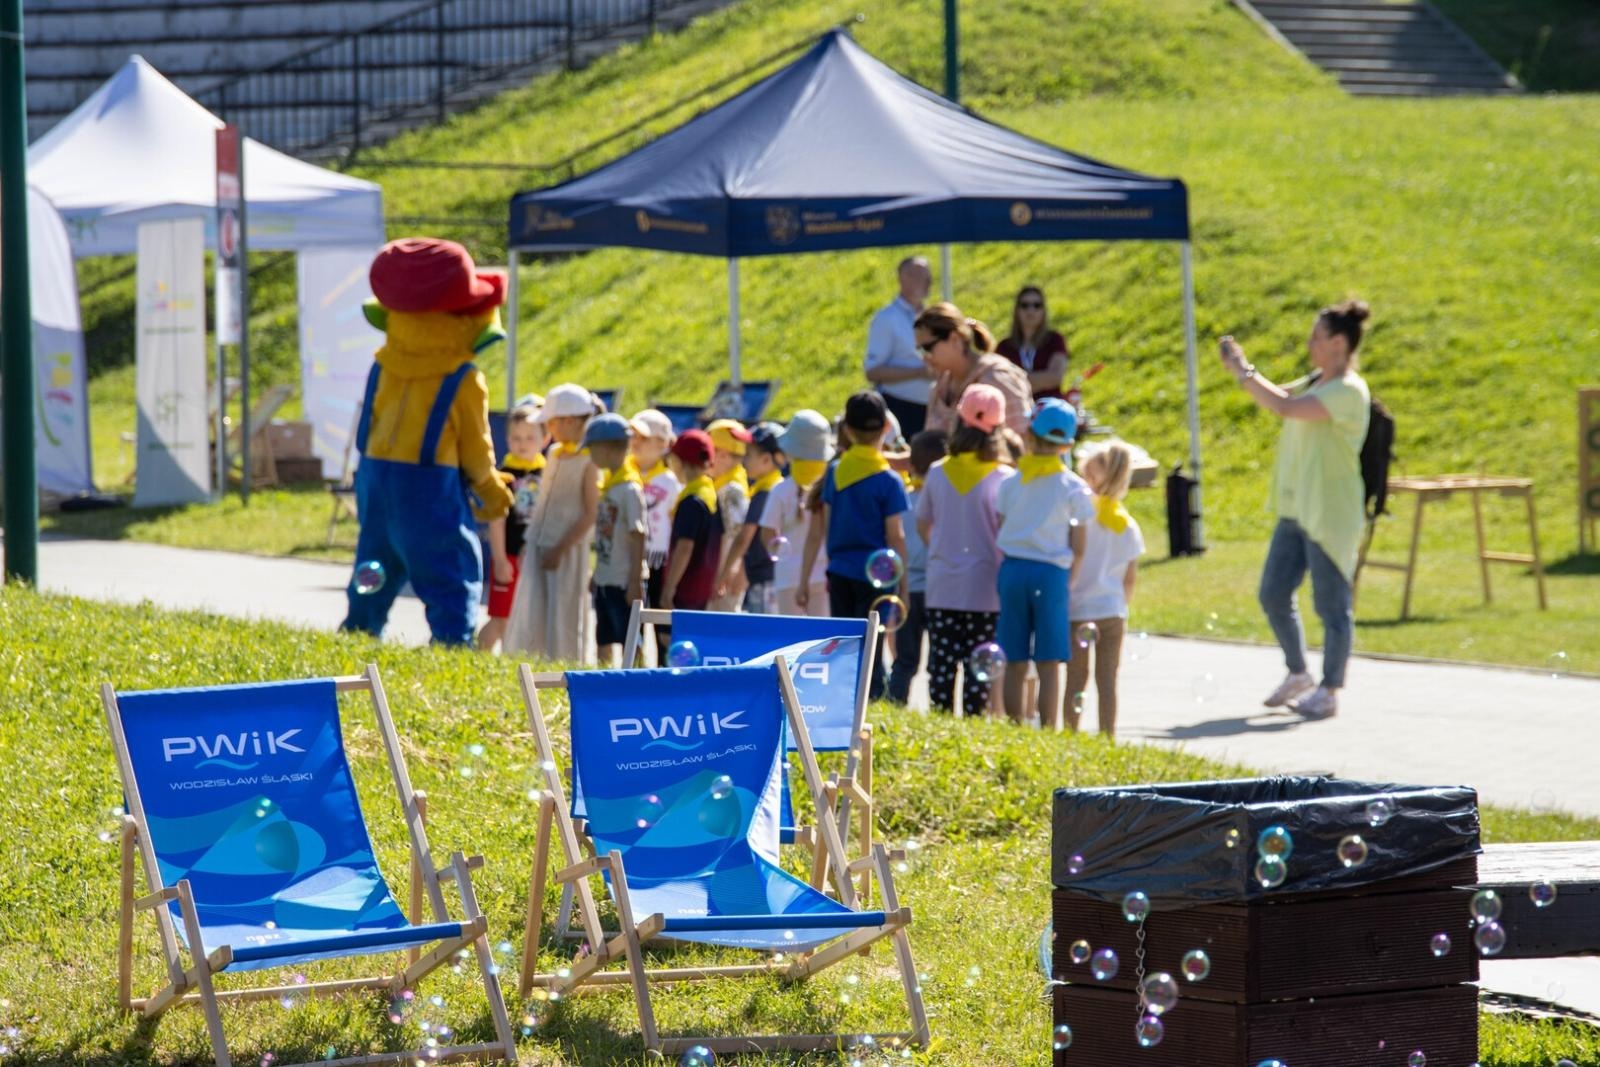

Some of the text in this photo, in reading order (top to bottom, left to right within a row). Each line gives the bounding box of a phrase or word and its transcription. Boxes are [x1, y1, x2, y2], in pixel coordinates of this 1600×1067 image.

[609, 710, 750, 742] PWiK
[162, 728, 306, 762] PWiK
[616, 755, 703, 770] WODZISŁAW
[169, 772, 313, 790] WODZISŁAW ŚLĄSKI
